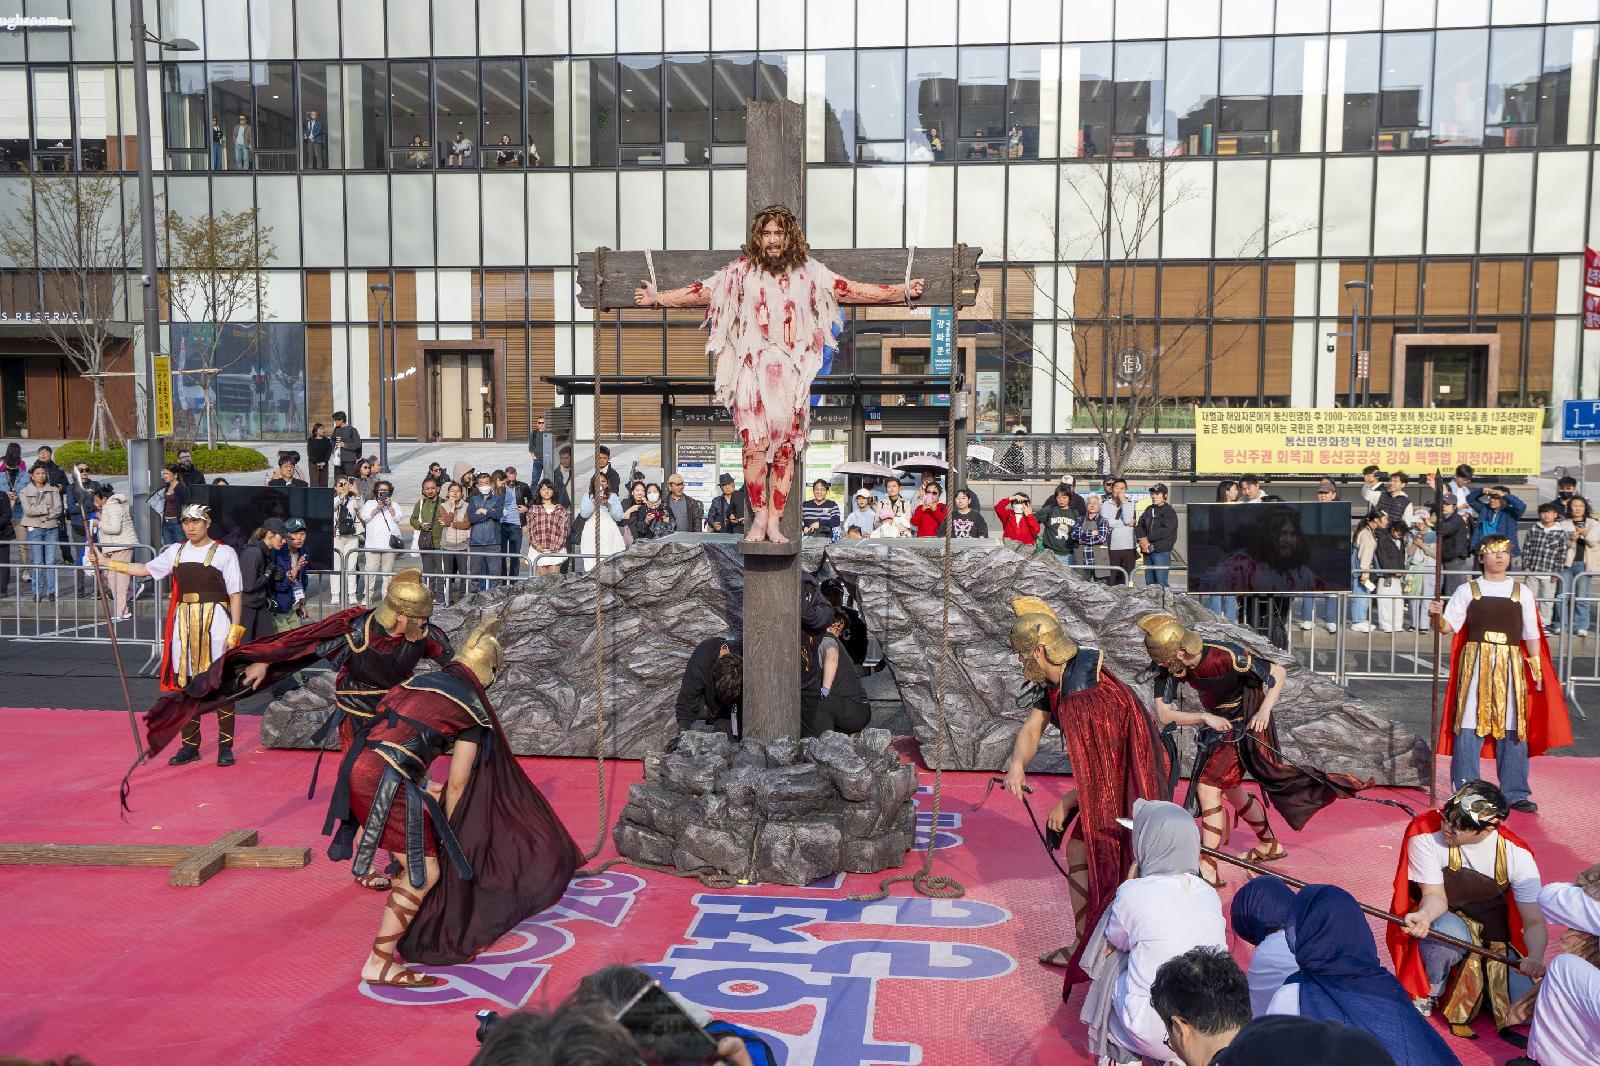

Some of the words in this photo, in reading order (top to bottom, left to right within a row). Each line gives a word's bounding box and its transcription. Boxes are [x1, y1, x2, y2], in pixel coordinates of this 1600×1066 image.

[1273, 411, 1311, 422] 통신민영화
[1221, 423, 1253, 435] 통신비에
[1255, 423, 1287, 434] 허덕이는
[1290, 423, 1314, 434] 국민은
[1337, 423, 1370, 435] 지속적인
[1372, 424, 1437, 435] 인력구조조정으로
[1466, 424, 1498, 435] 노동자는
[1285, 436, 1361, 448] 통신민영화정책
[1365, 436, 1397, 448] 완전히
[1402, 437, 1453, 448] 실패했다!!
[1223, 449, 1272, 465] 통신주권
[1277, 449, 1314, 465] 회복과
[1319, 449, 1381, 465] 통신공공성
[1386, 450, 1411, 466] 강화
[1415, 450, 1451, 466] 특별법
[1456, 450, 1514, 466] 제정하라!!
